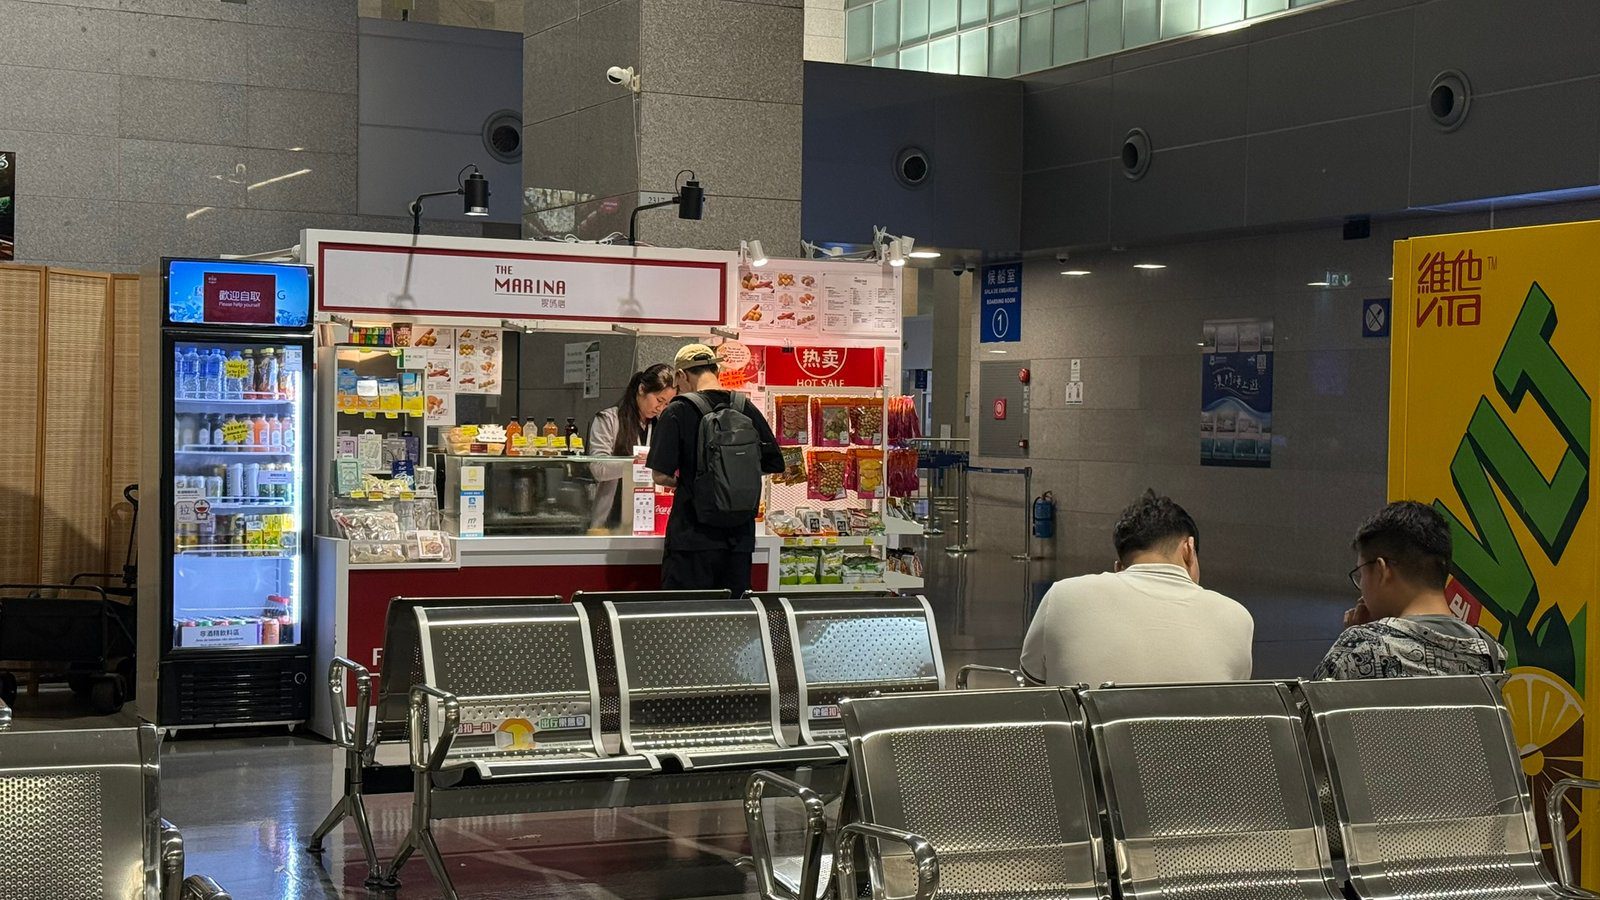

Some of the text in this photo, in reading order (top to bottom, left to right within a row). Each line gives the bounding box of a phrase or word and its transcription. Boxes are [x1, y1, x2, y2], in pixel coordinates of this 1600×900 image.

[495, 265, 513, 274] THE
[1417, 249, 1482, 293] 維他
[494, 277, 566, 295] MARINA
[219, 290, 261, 301] 歡迎自取
[802, 348, 839, 369] 热卖
[797, 379, 818, 387] HOT
